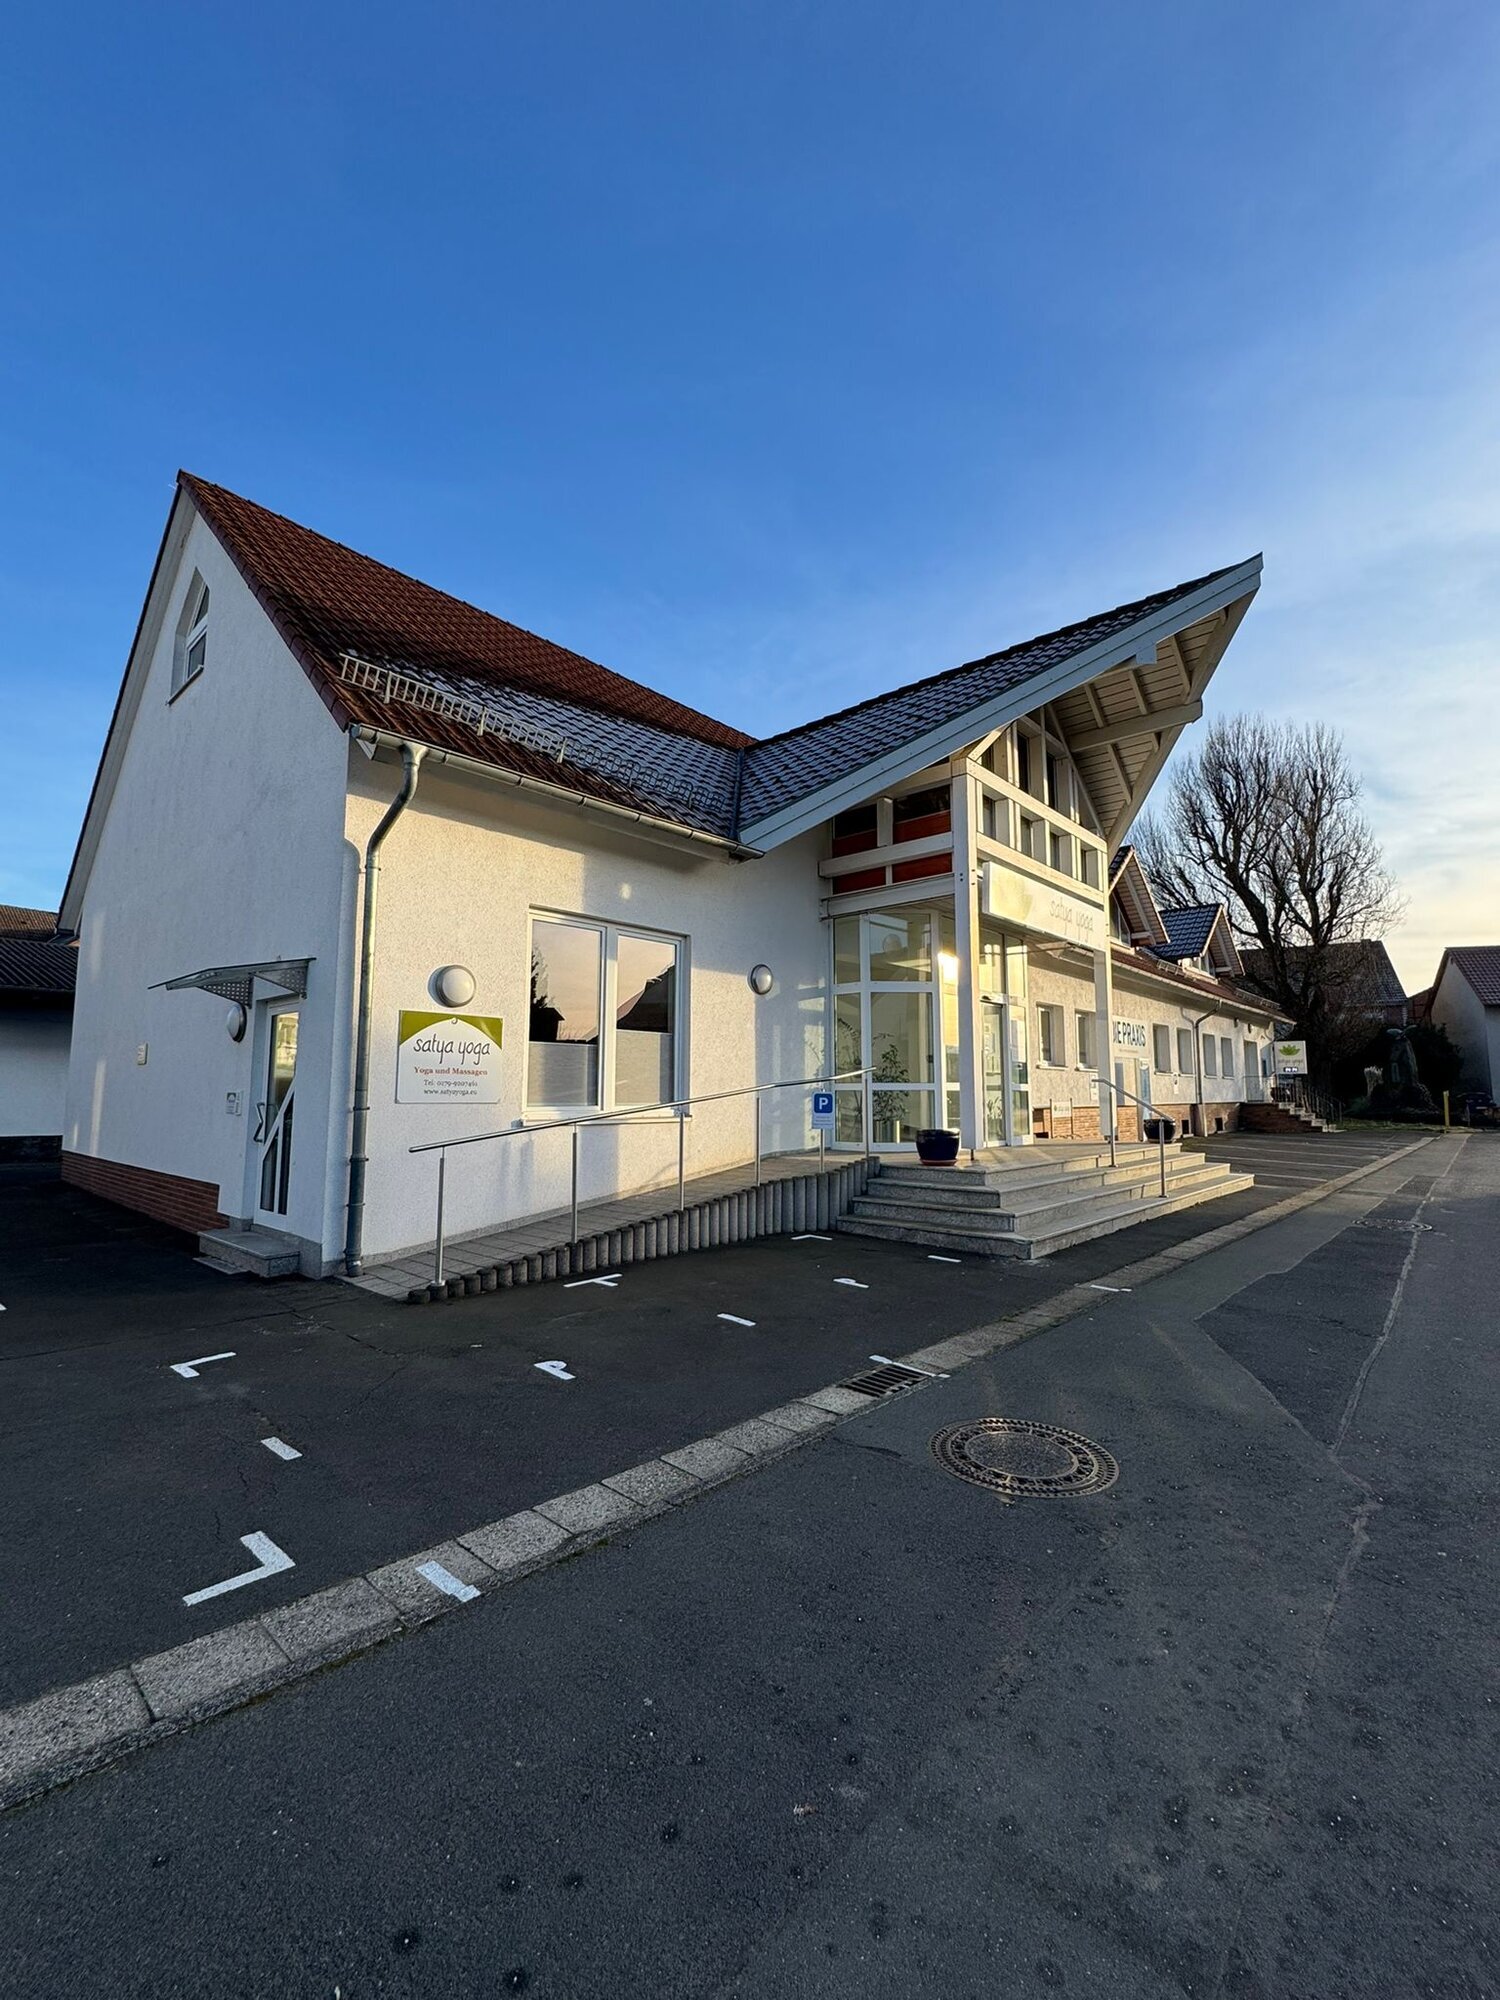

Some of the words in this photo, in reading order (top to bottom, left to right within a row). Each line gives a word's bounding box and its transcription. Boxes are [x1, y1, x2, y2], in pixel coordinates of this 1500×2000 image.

[413, 1033, 454, 1064] satya
[458, 1040, 490, 1065] yoga
[414, 1066, 434, 1075] Yoga
[451, 1067, 488, 1076] Massagen
[819, 1097, 829, 1110] P
[533, 1360, 576, 1380] P
